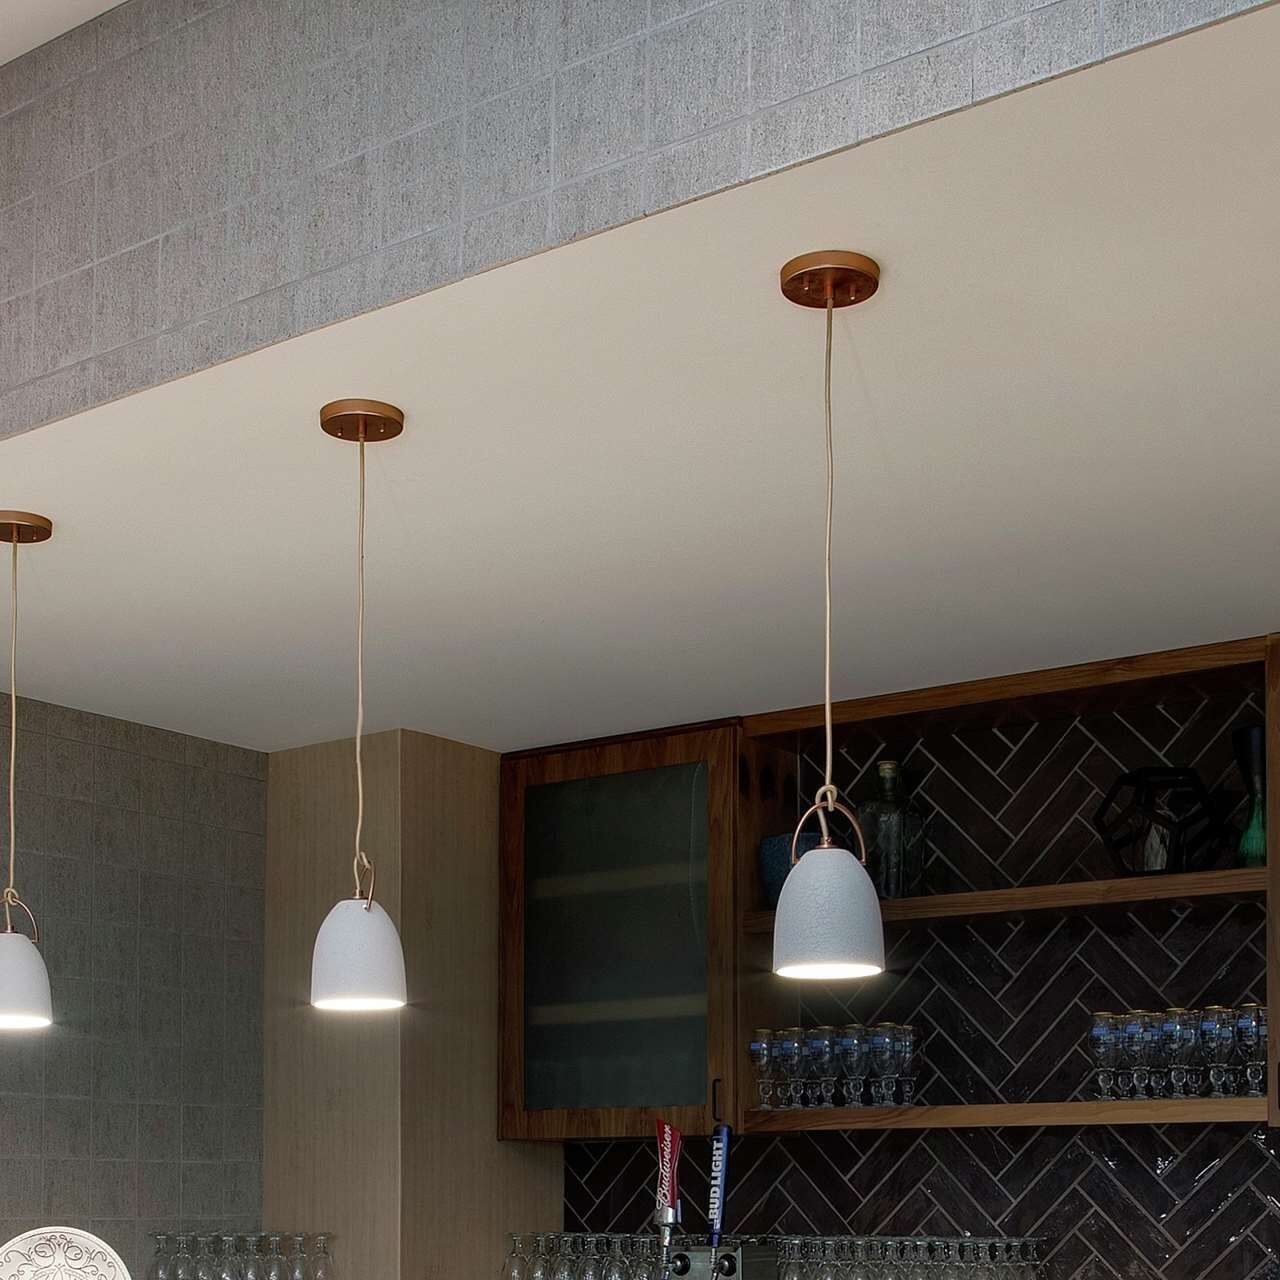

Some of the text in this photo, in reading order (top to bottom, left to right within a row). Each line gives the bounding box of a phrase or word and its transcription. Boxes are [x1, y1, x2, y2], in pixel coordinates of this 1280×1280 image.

[656, 1124, 672, 1209] Budweiser
[708, 1141, 723, 1219] BUD LIGHT
